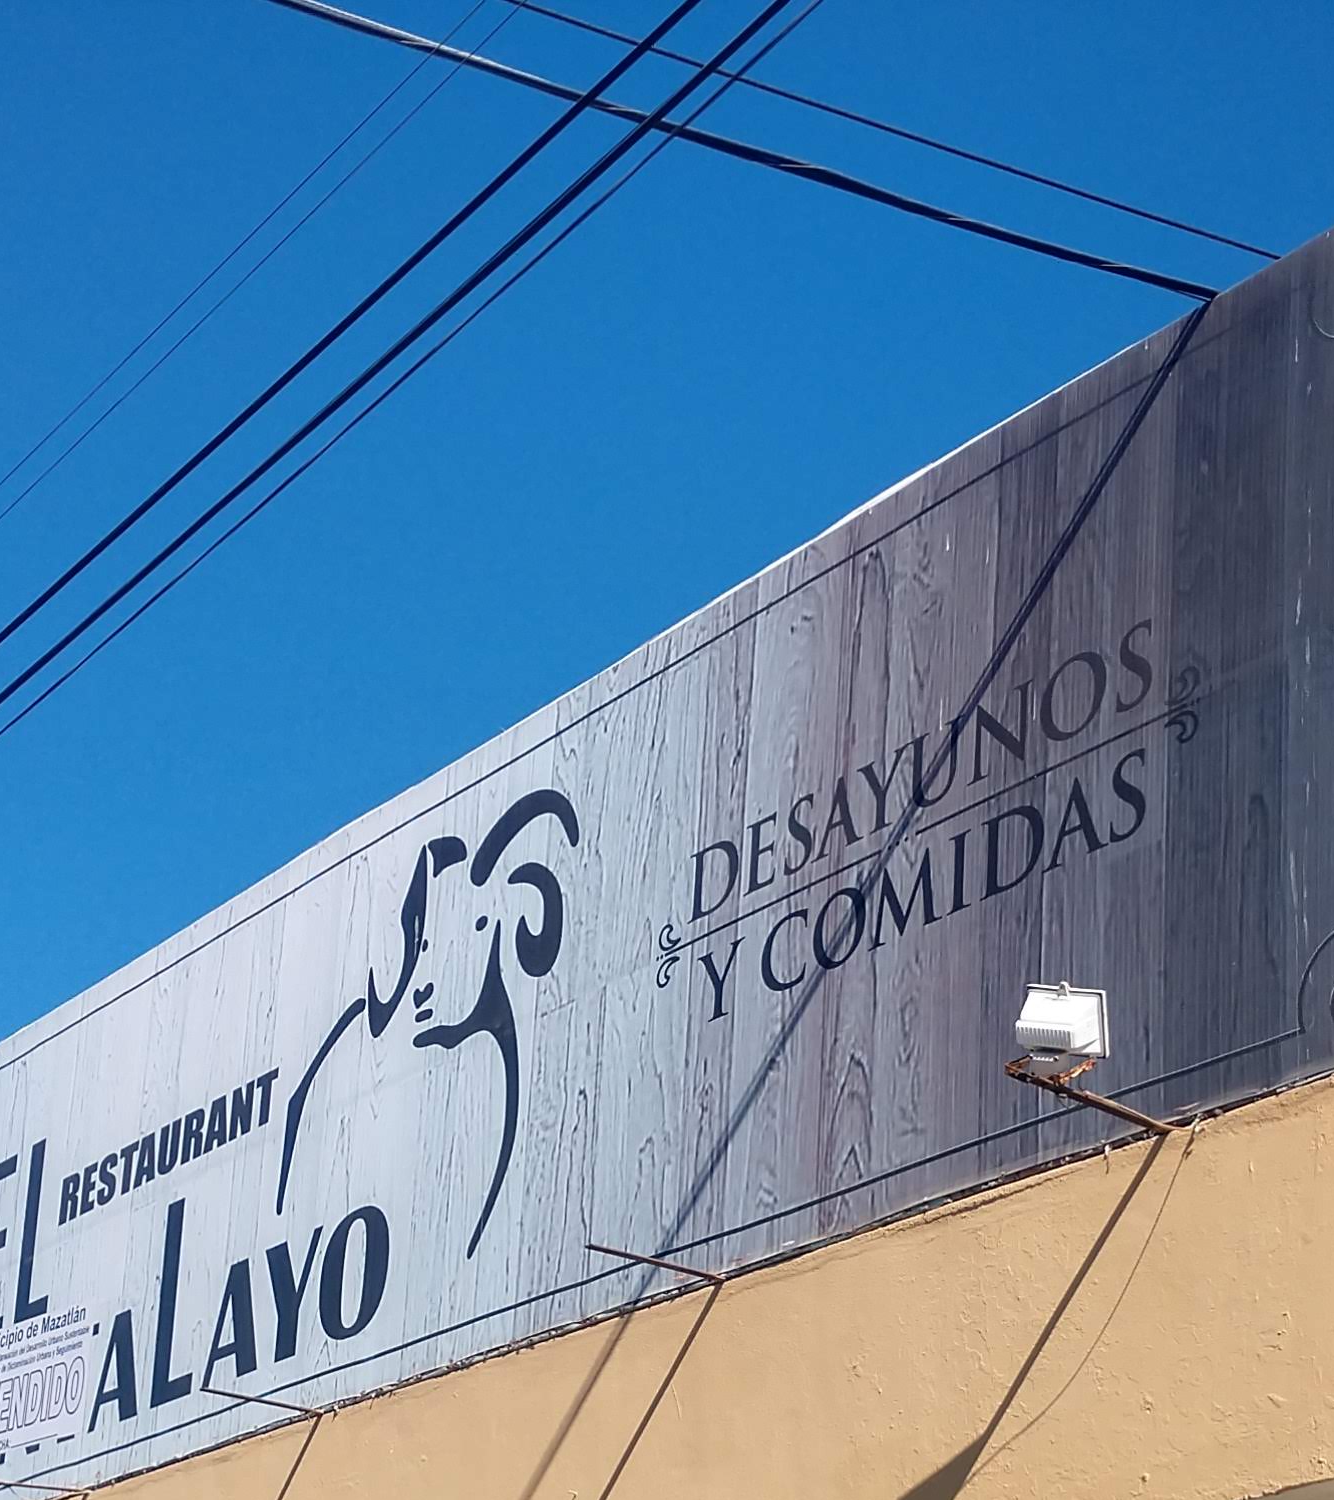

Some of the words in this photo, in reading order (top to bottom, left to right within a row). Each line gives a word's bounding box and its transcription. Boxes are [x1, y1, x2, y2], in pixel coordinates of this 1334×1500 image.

[686, 617, 1153, 926] DESAYUNOS
[697, 936, 746, 1023] Y
[759, 747, 1148, 993] COMIDAS
[57, 1067, 280, 1227] RESTAURANT
[26, 1322, 39, 1339] de
[41, 1305, 87, 1333] Mazatlán
